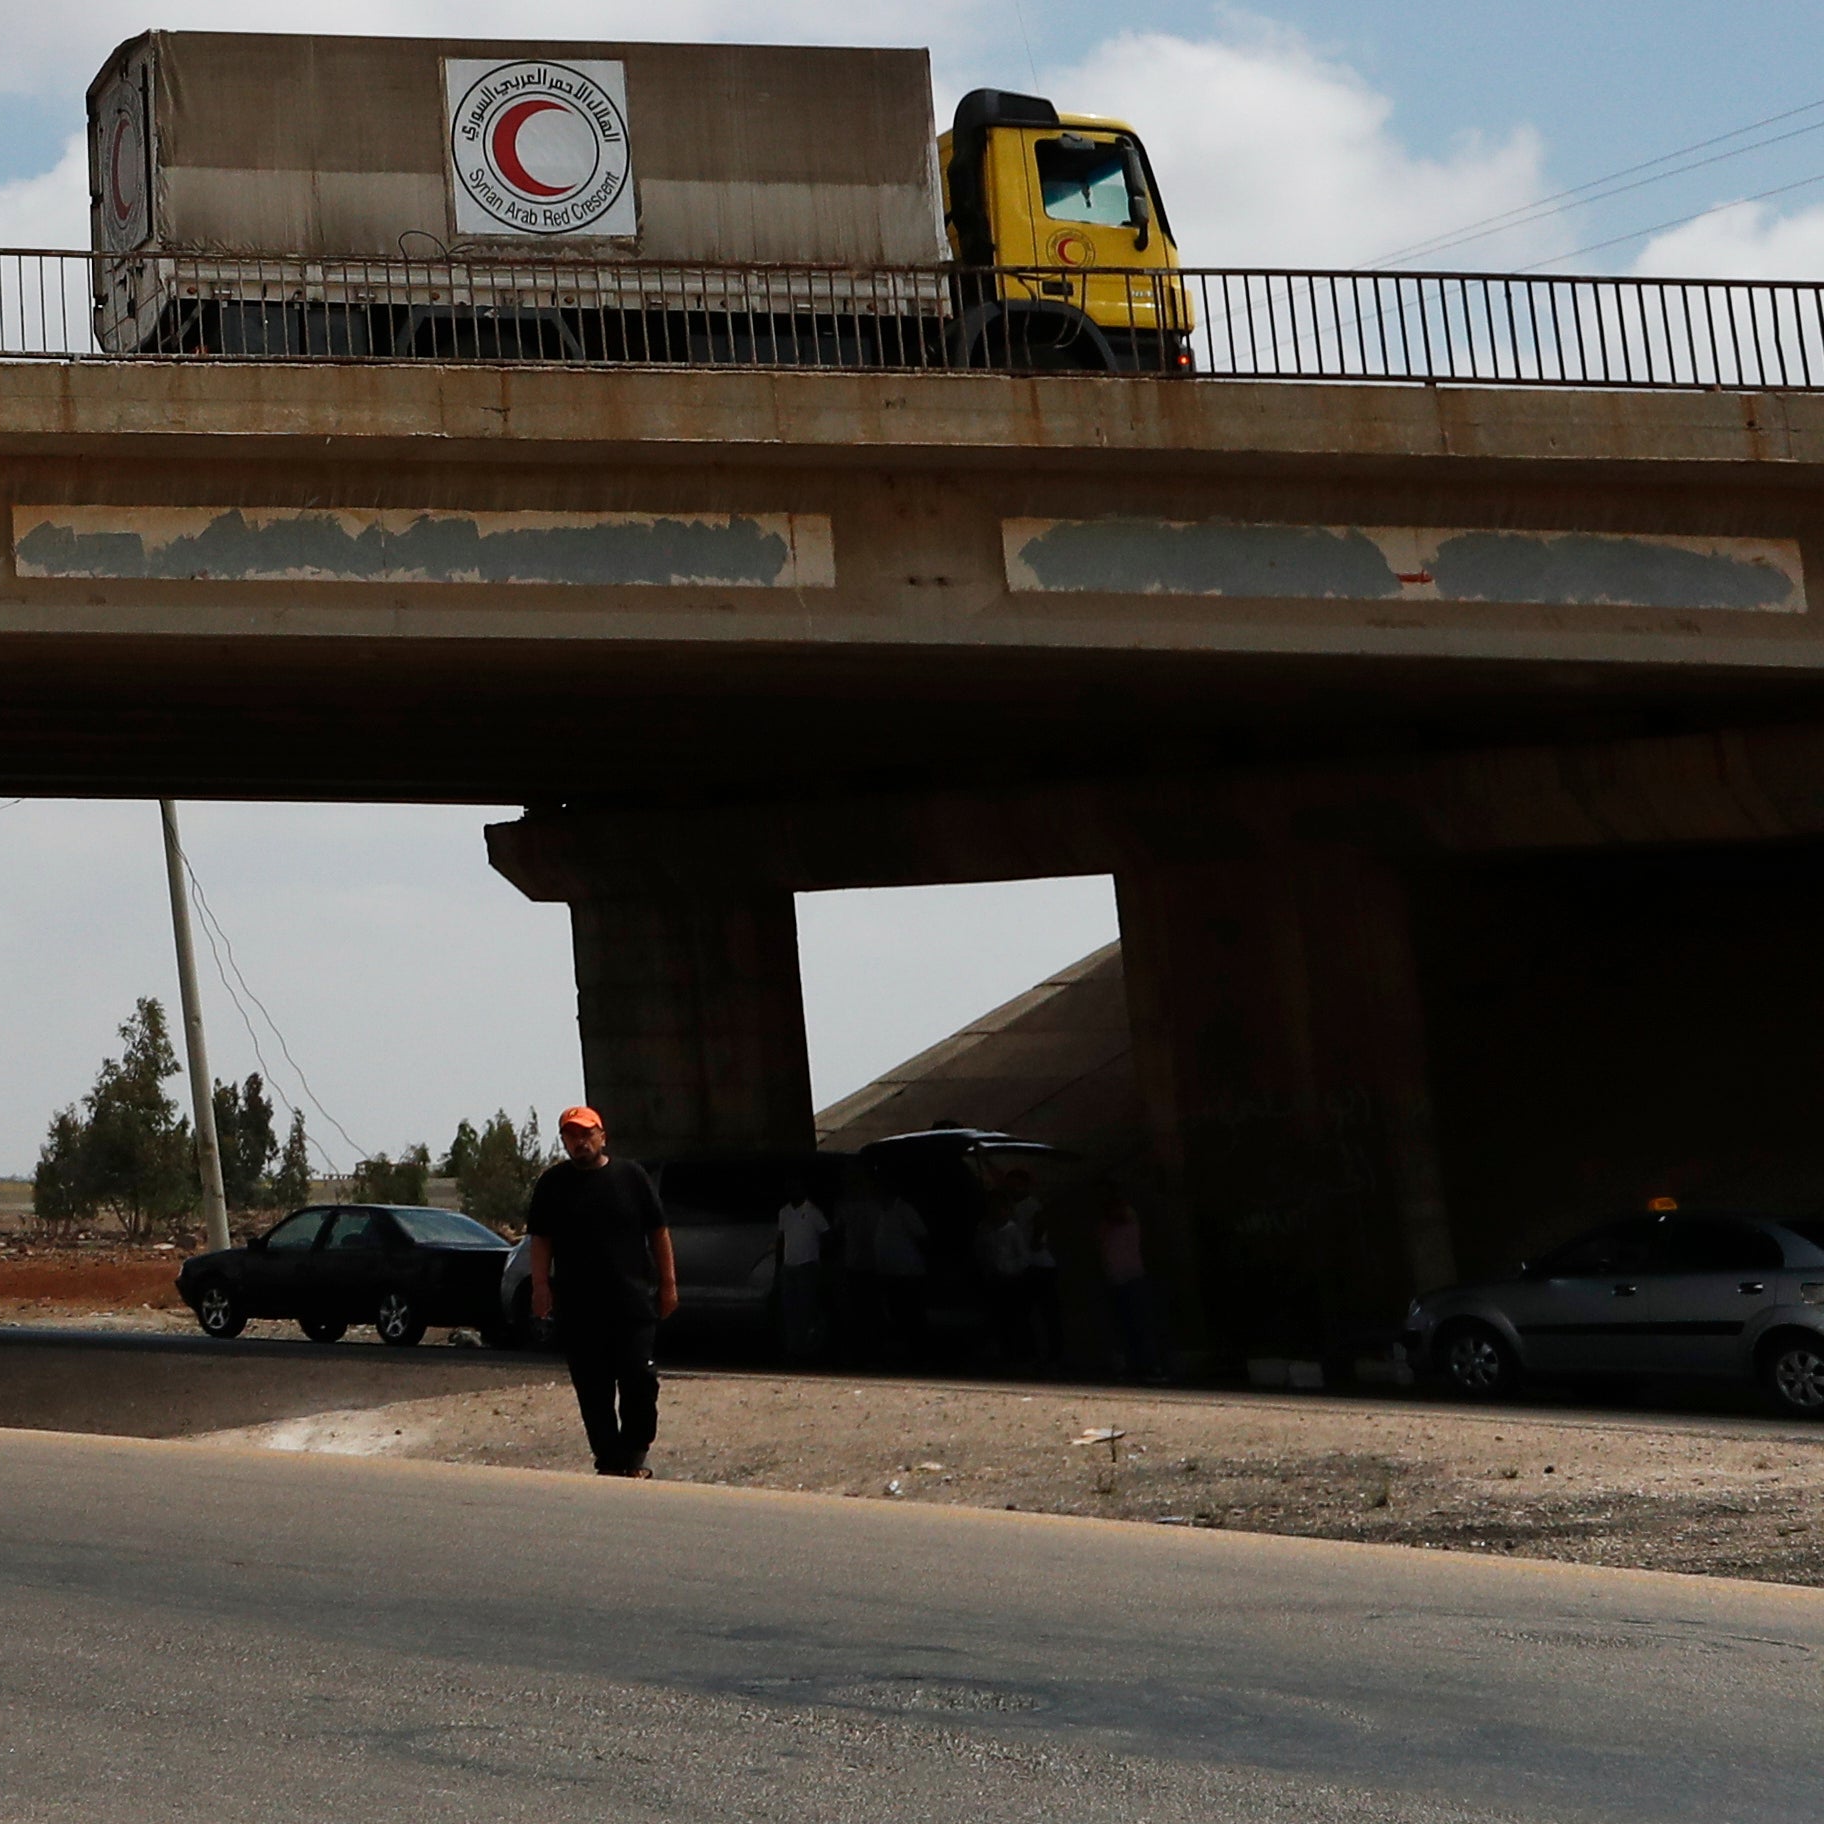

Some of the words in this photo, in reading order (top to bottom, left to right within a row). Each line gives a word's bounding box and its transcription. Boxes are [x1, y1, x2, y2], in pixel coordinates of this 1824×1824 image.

[494, 68, 547, 96] العربي
[462, 85, 497, 142] السوري
[586, 100, 621, 142] الهلال
[469, 168, 503, 211] Syrian
[505, 202, 538, 226] Arab
[543, 208, 570, 227] Red
[571, 170, 620, 220] Crescent
